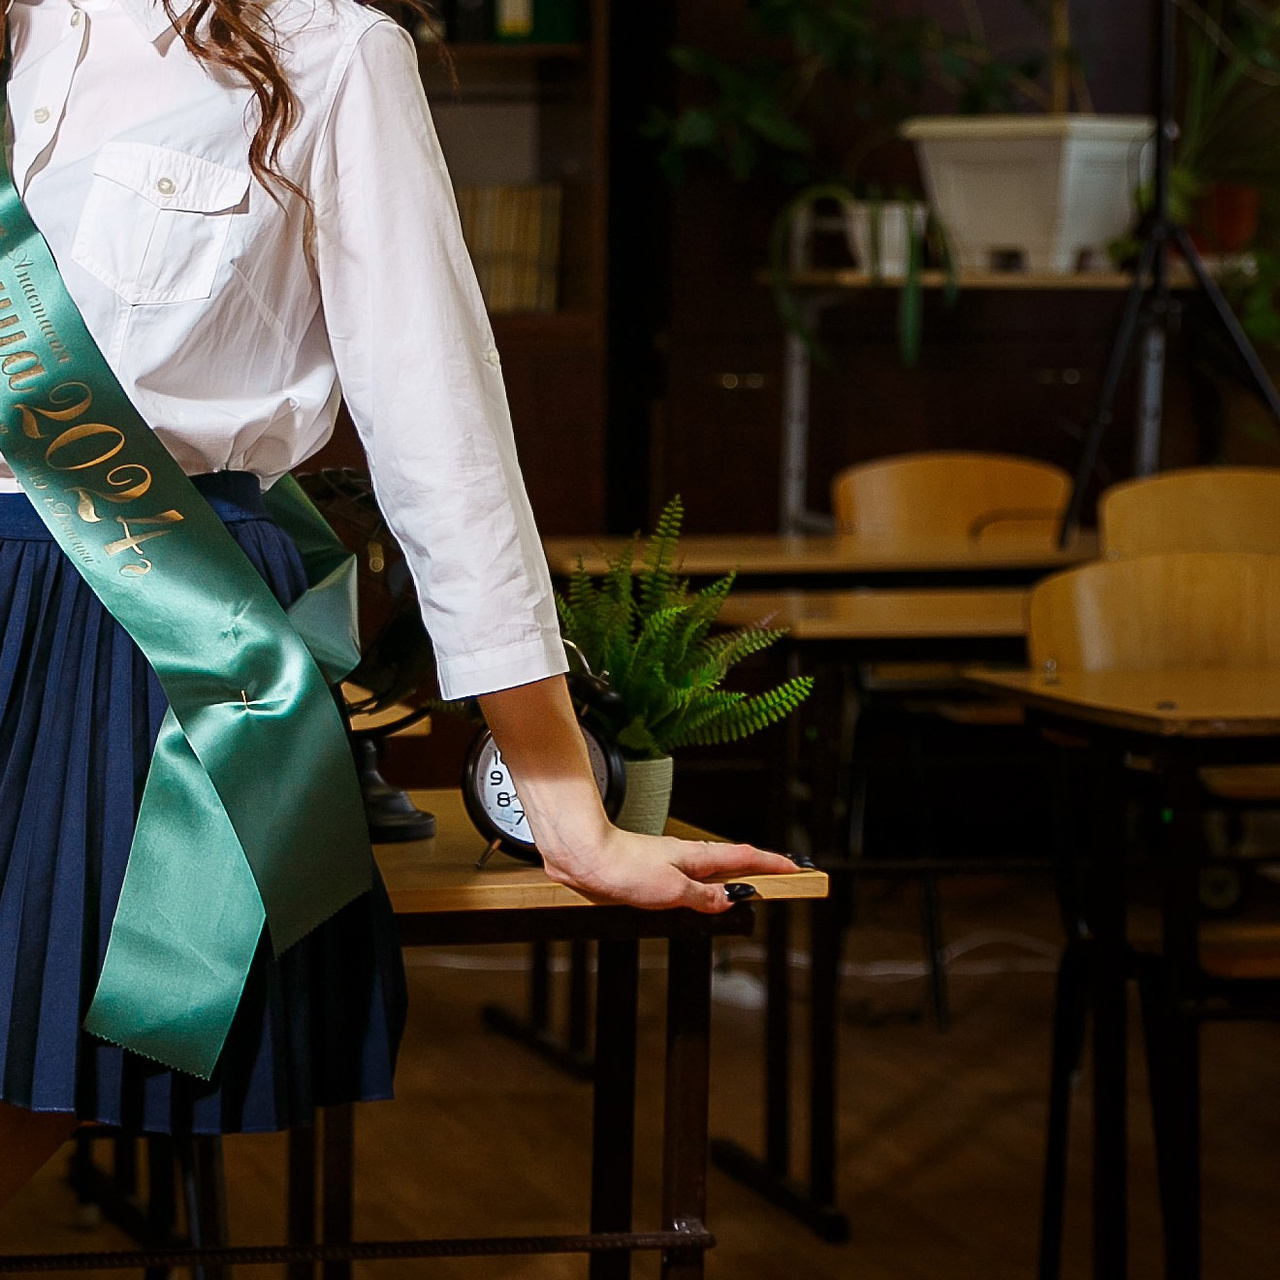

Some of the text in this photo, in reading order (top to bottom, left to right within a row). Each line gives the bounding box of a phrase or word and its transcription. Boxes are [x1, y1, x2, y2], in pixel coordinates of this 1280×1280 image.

[7, 246, 70, 364] Анастасия
[11, 381, 184, 556] 2024
[490, 770, 504, 786] 9
[496, 792, 511, 807] 8
[513, 811, 526, 825] 7
